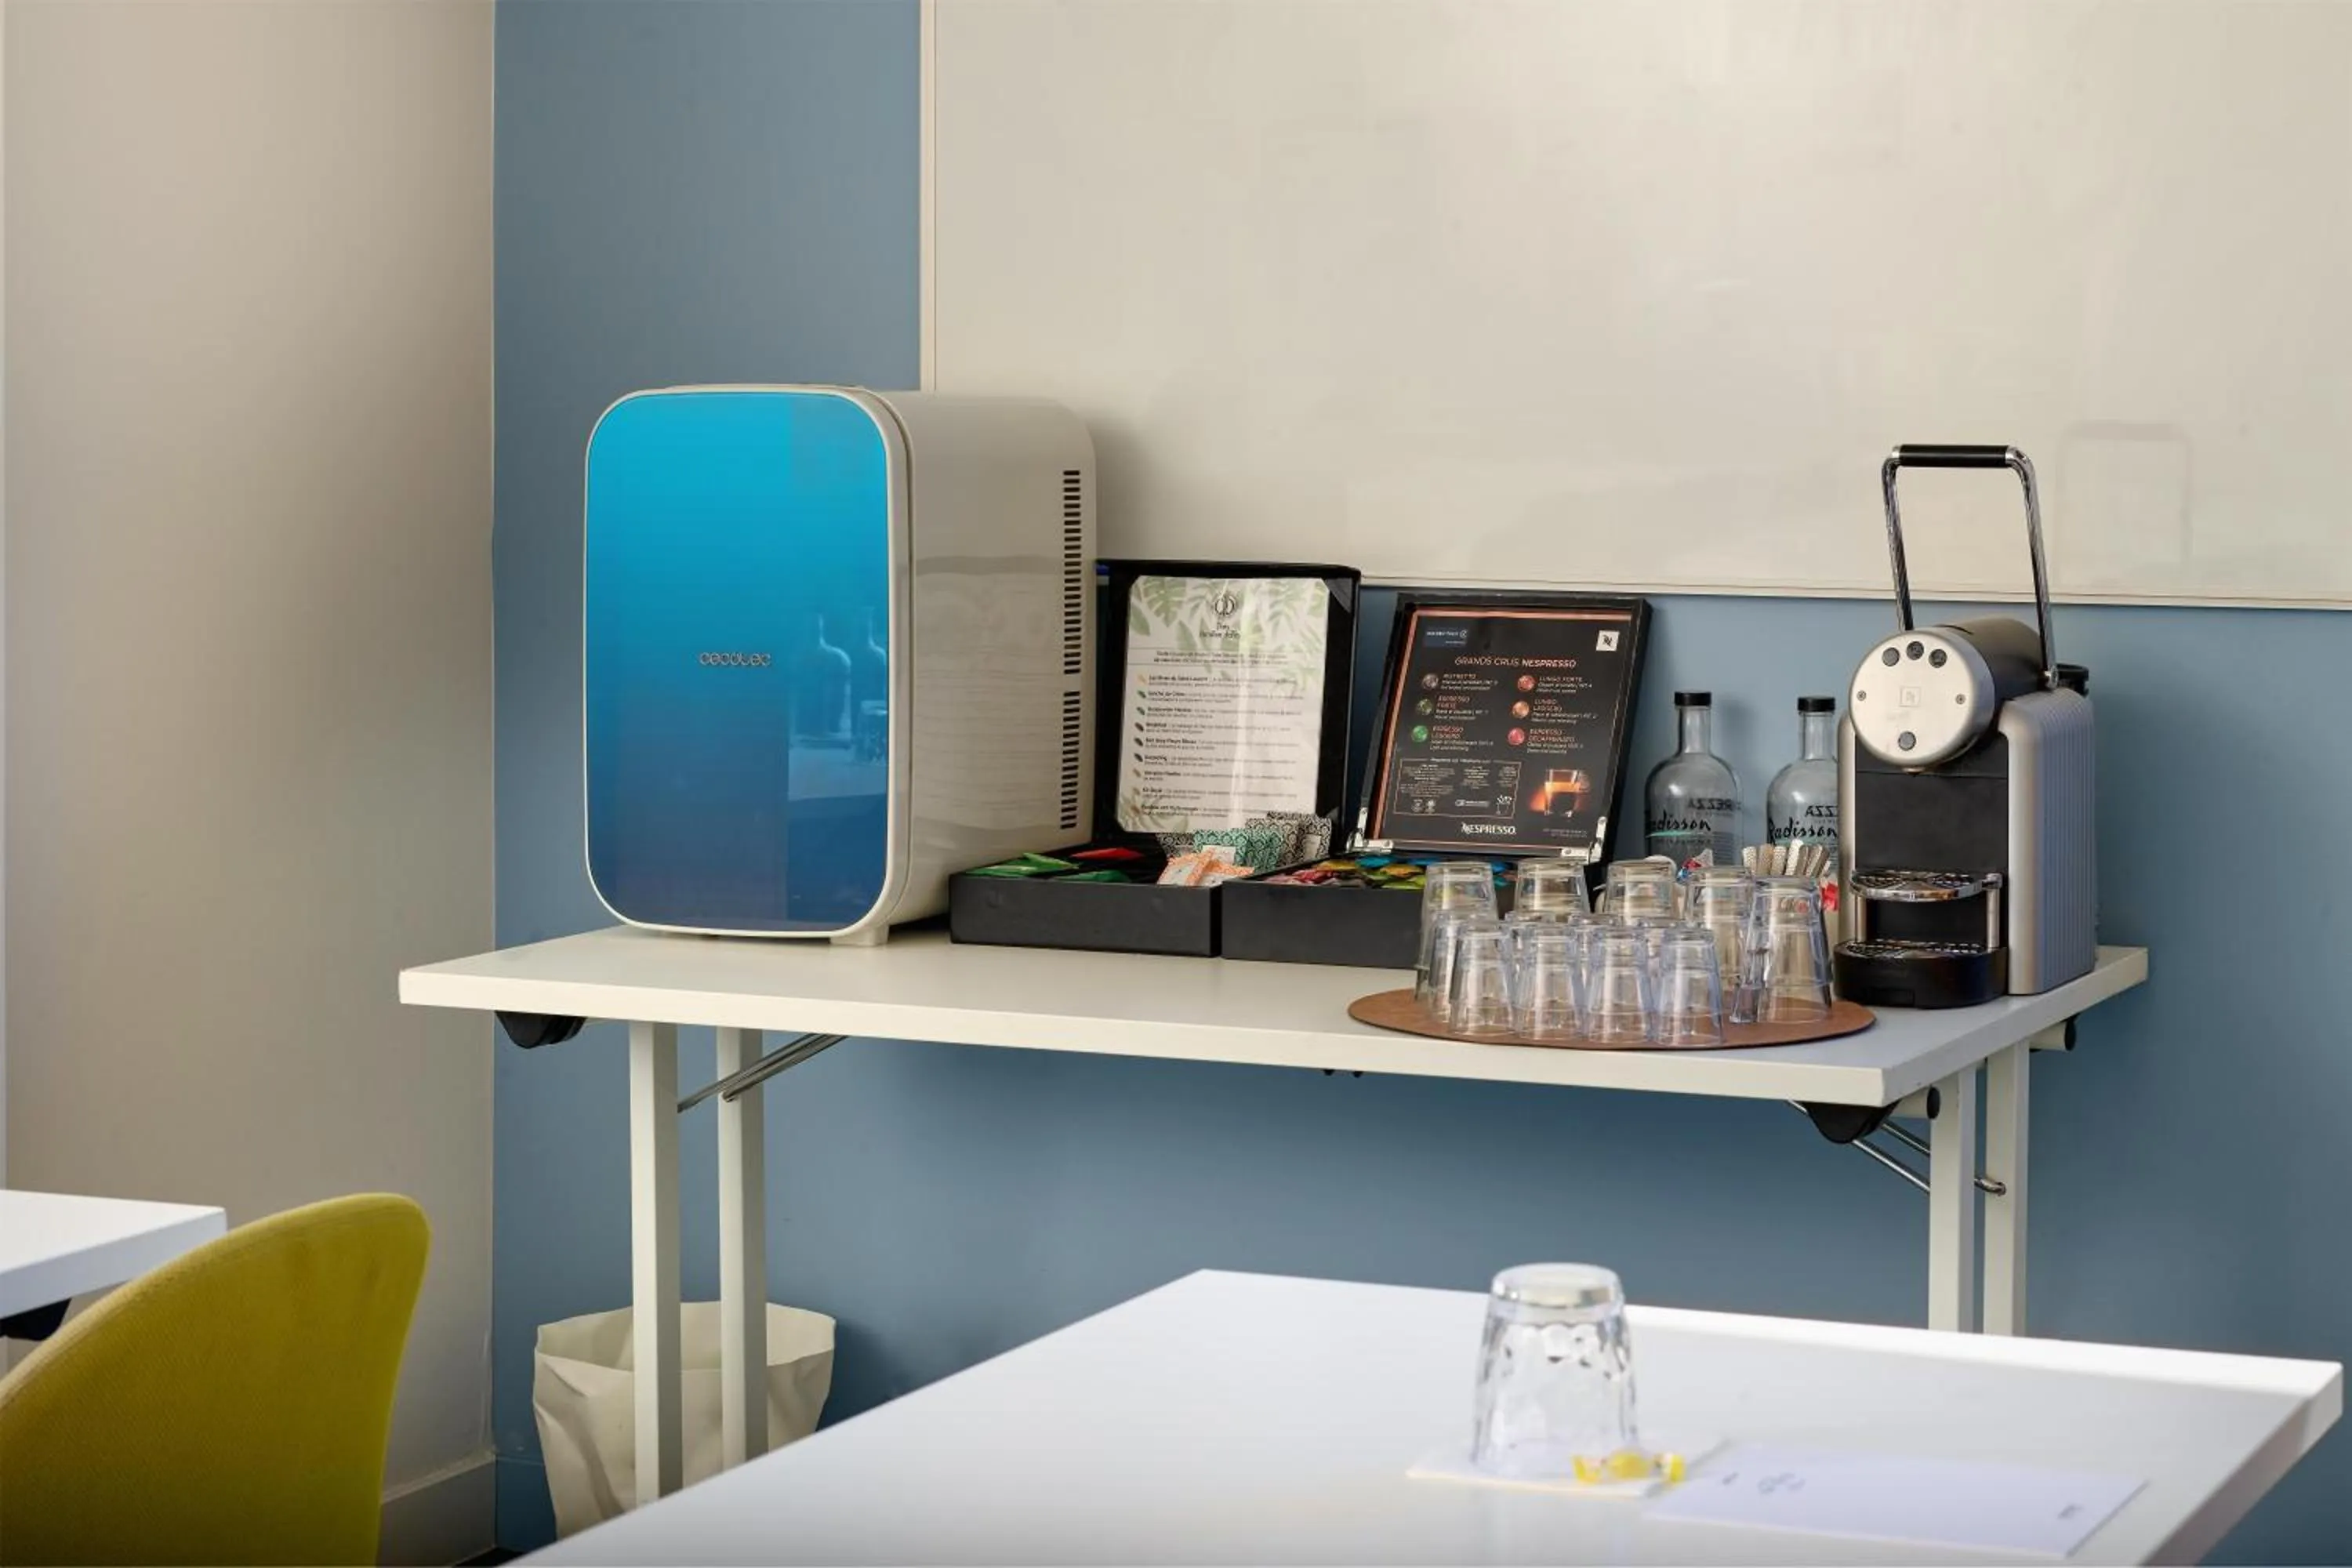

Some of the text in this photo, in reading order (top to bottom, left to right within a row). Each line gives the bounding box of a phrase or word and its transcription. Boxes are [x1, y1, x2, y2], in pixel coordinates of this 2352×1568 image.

[1454, 656, 1577, 669] GRANDS CRUS NESPRESSO
[1461, 822, 1517, 835] NESPRESSO
[1768, 816, 1838, 845] Radisson
